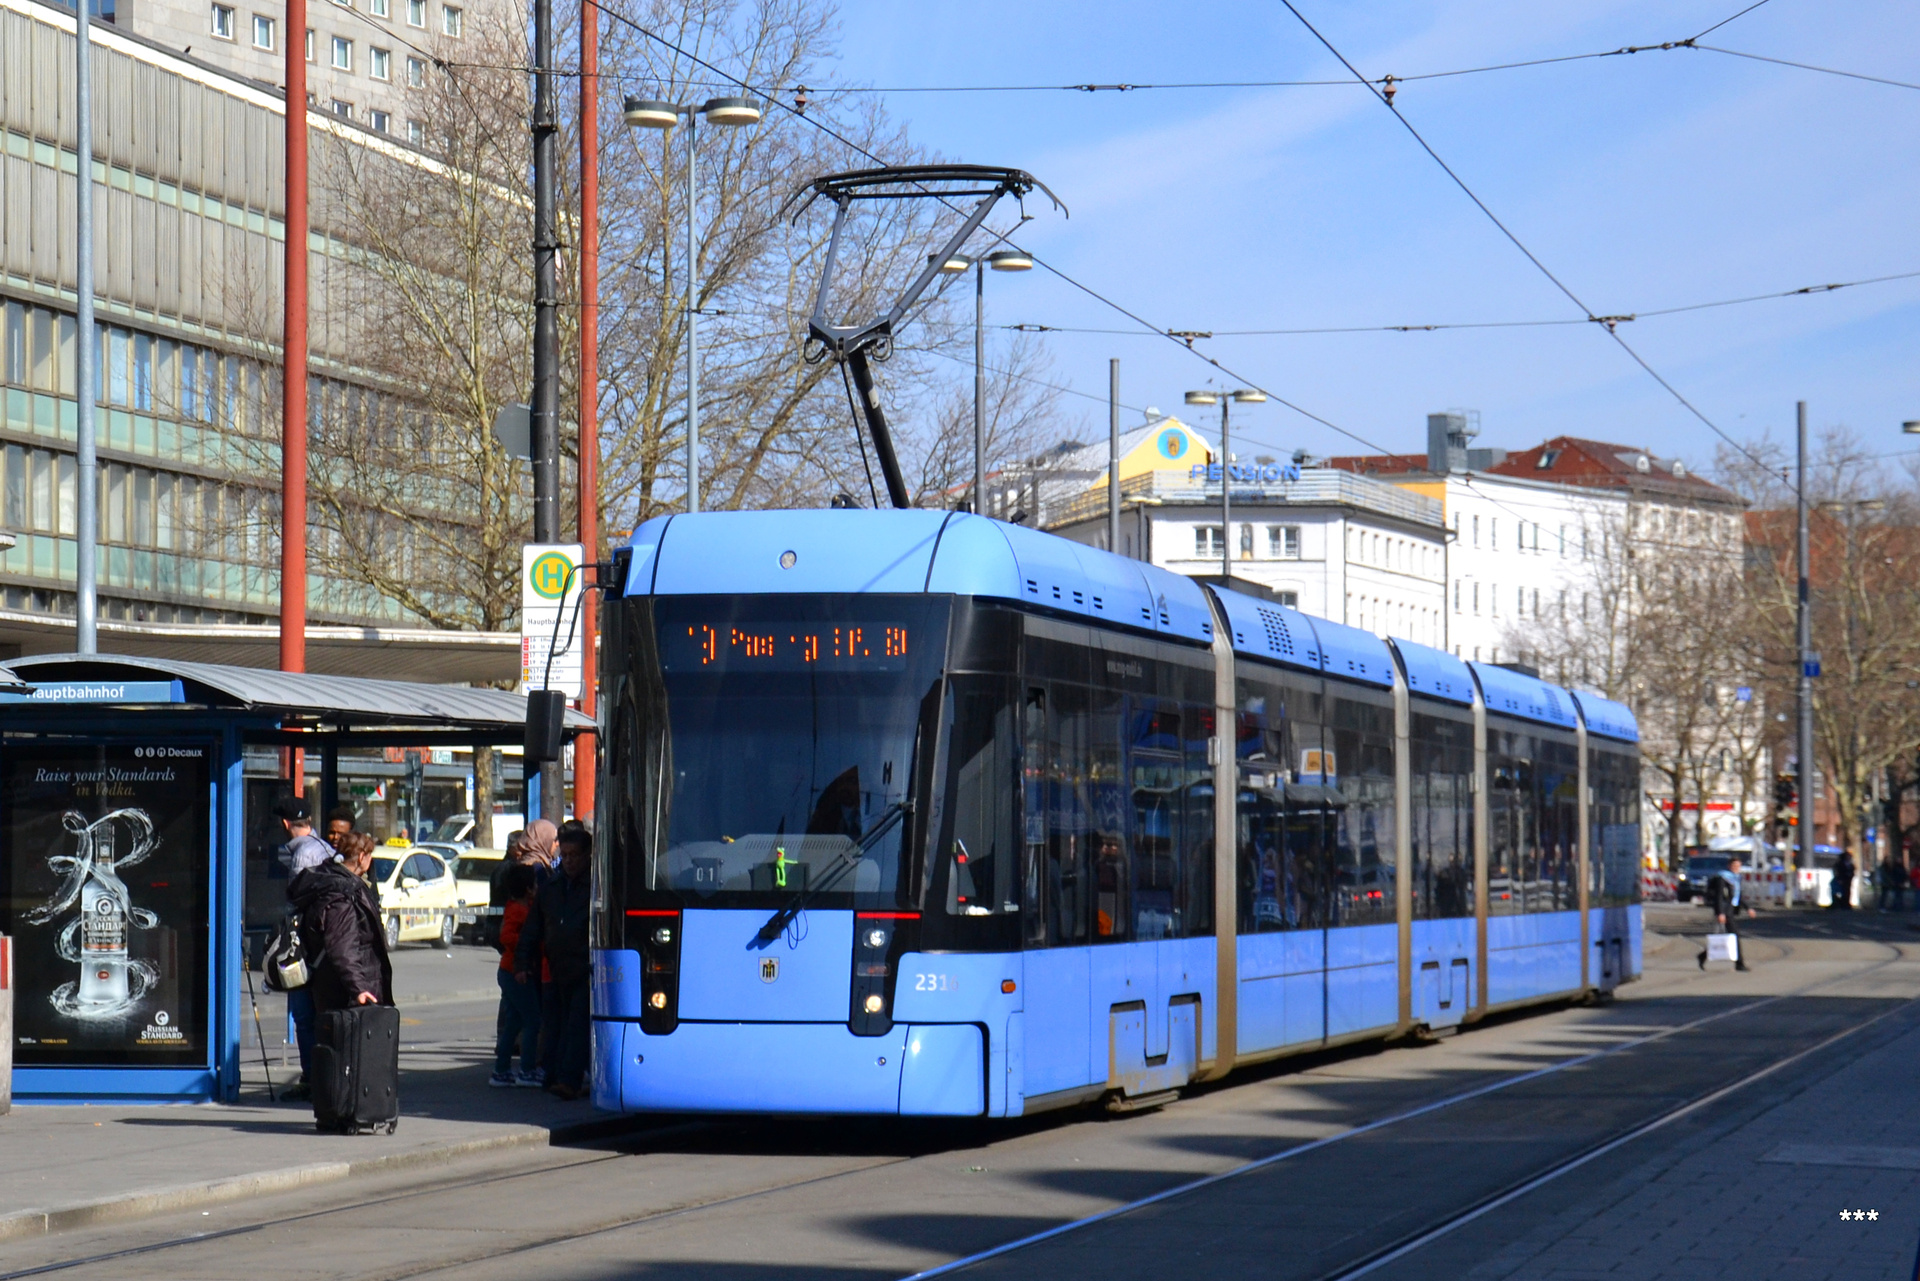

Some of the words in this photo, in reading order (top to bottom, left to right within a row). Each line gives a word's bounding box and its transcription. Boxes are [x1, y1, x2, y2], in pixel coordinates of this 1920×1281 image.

[1192, 463, 1301, 480] PENSION
[542, 563, 563, 589] H
[167, 747, 202, 758] Decaux
[35, 767, 71, 782] Raise
[72, 770, 105, 786] your
[107, 767, 175, 782] Standards
[76, 783, 90, 795] in
[95, 782, 136, 796] Vodka.
[141, 1030, 183, 1040] STANDARD
[147, 1024, 178, 1033] RUSSIAN
